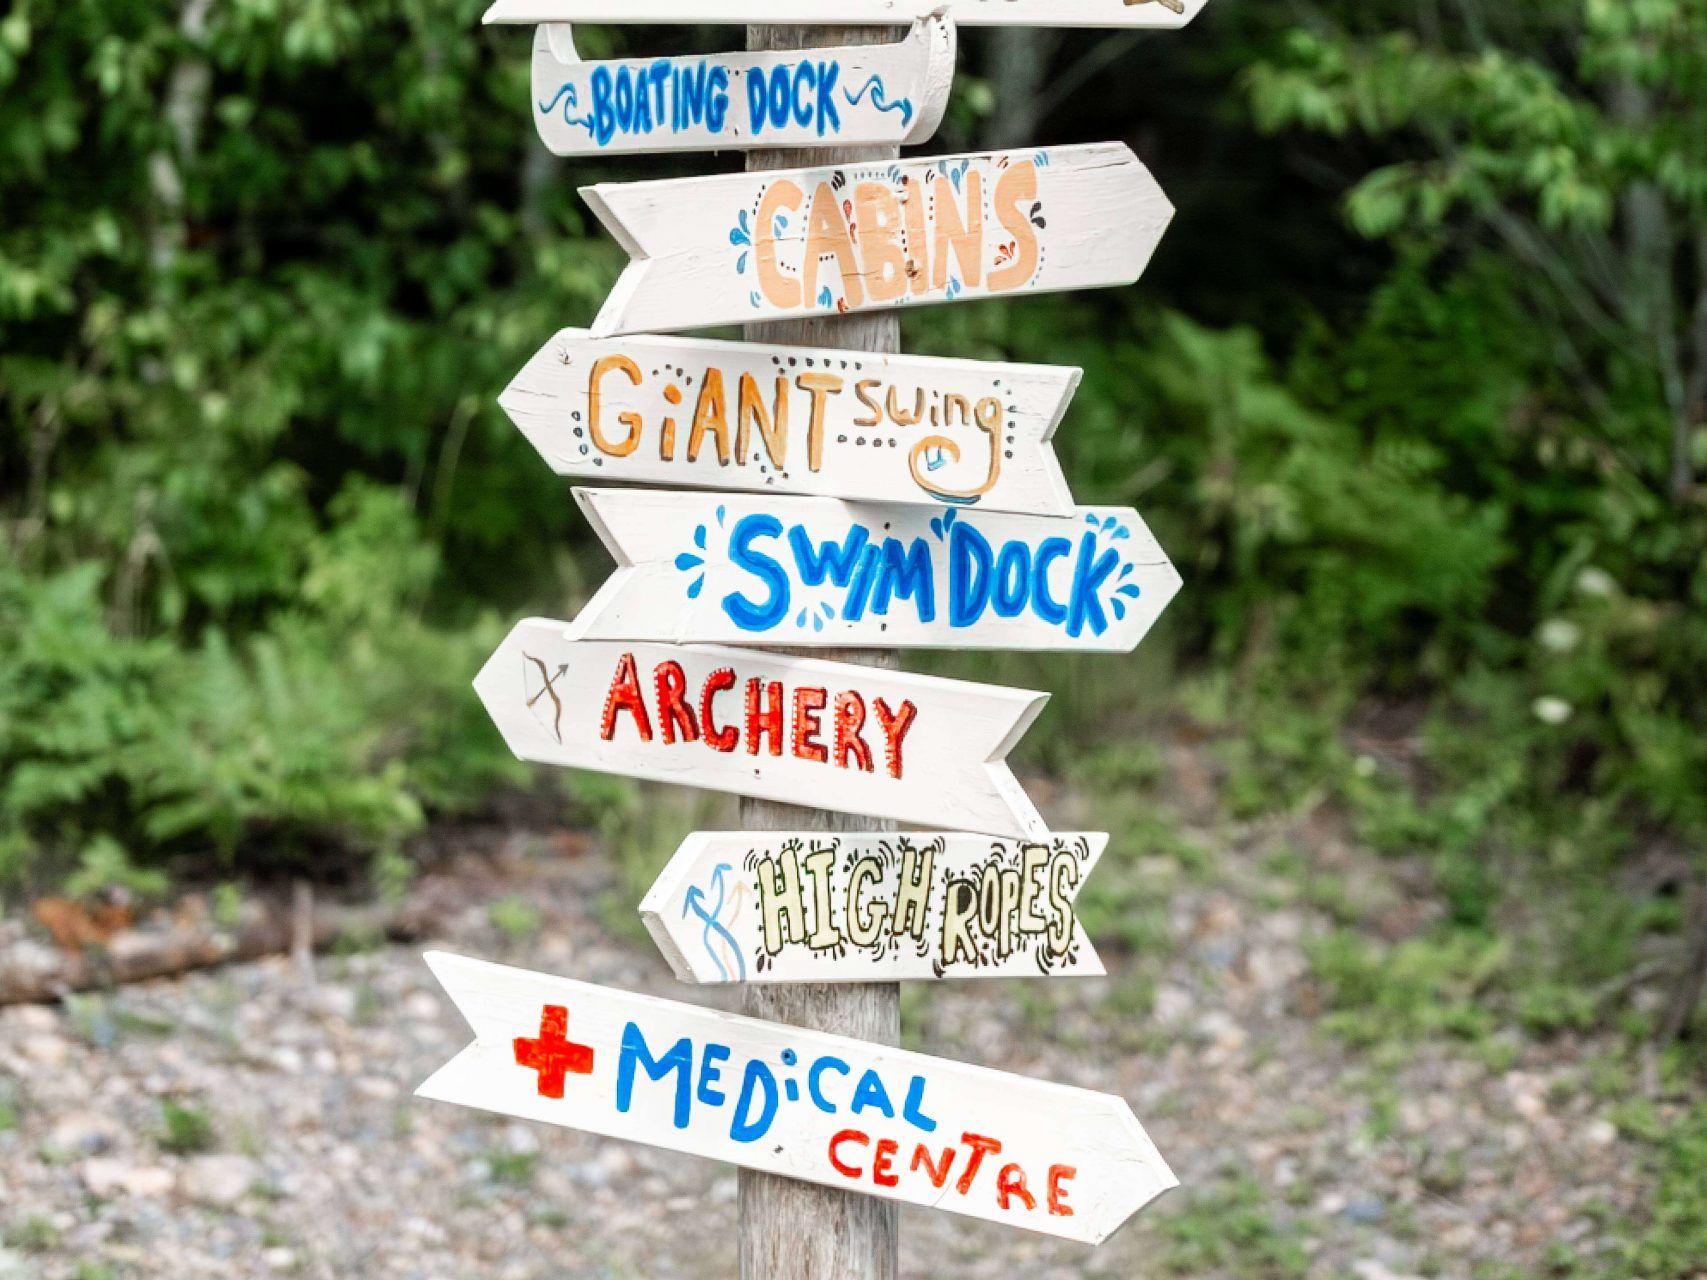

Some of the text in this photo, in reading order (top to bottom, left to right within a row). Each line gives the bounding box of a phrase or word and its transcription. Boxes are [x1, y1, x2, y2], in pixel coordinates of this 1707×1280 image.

[590, 60, 841, 147] BOATING DOCK
[752, 158, 1039, 311] CABINS
[721, 513, 1122, 638] SWIM DOCK
[599, 652, 919, 780] ARCHERY
[755, 843, 1080, 966] HIGH ROPES
[828, 1127, 1077, 1218] CENTRE
